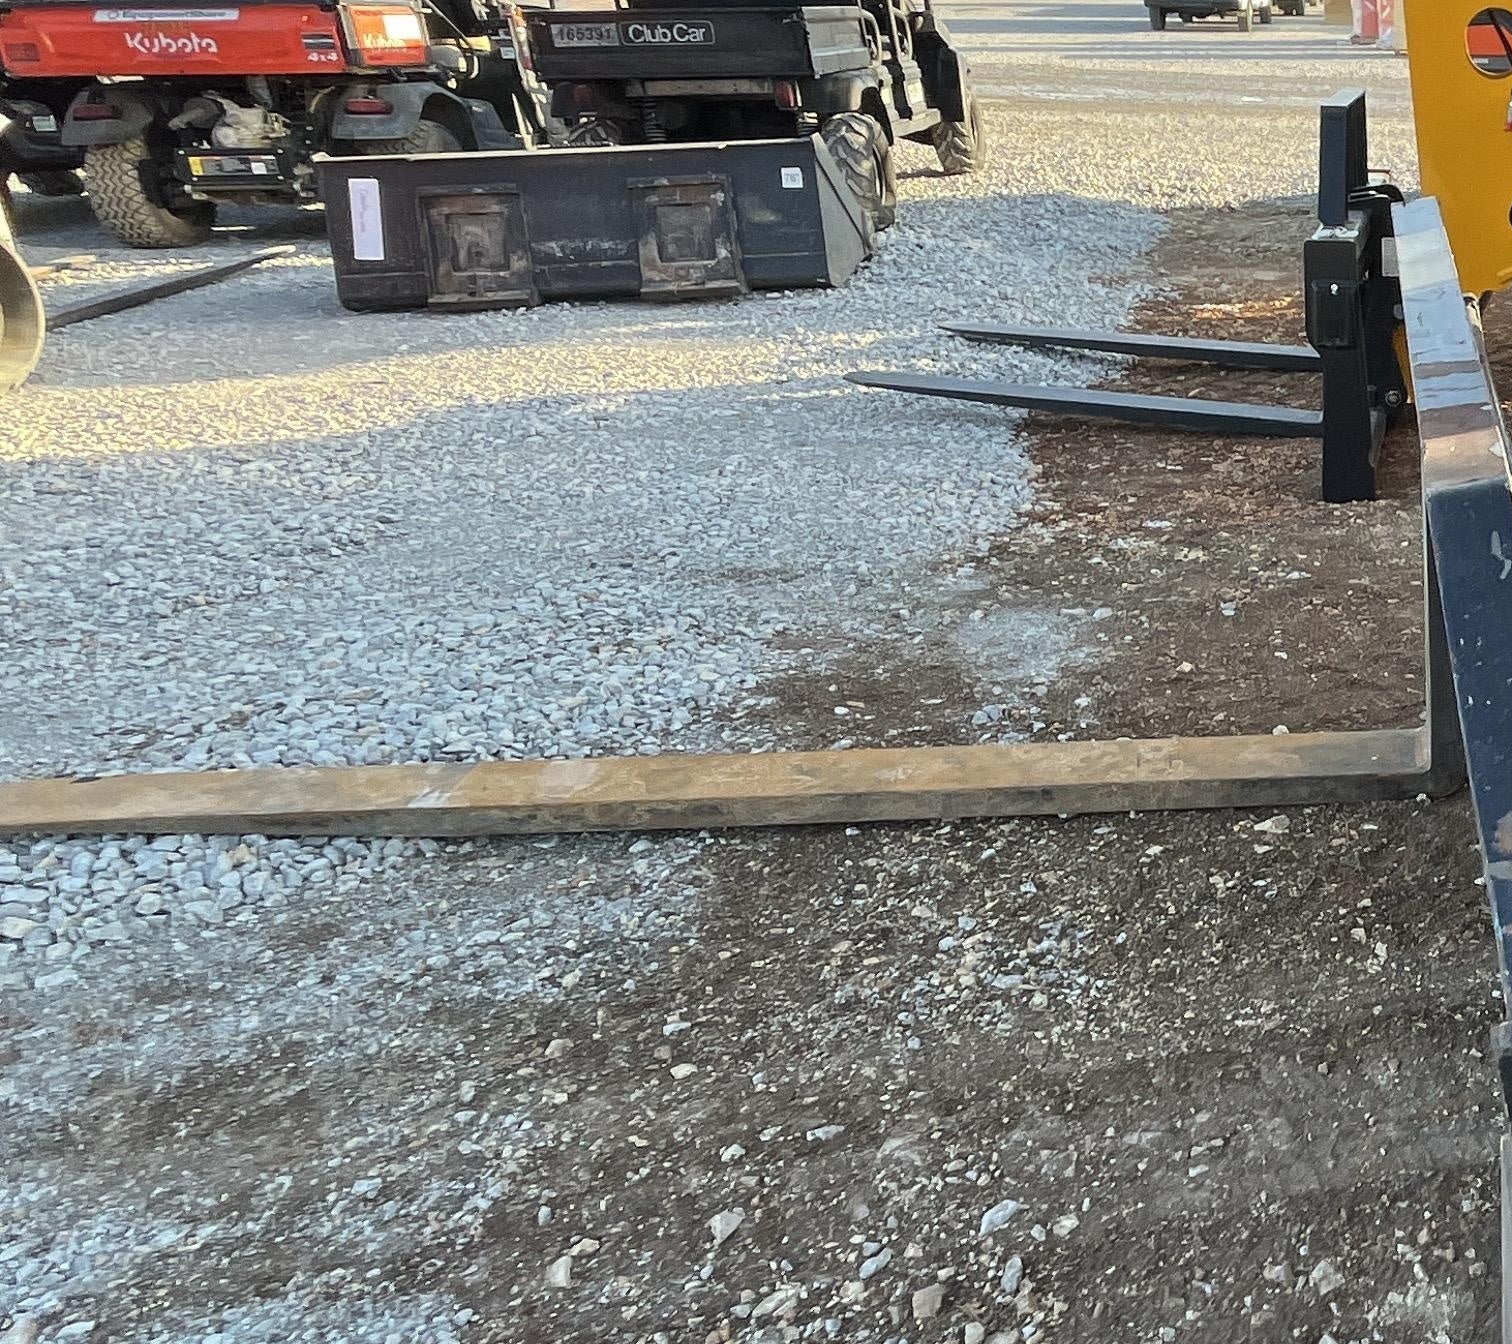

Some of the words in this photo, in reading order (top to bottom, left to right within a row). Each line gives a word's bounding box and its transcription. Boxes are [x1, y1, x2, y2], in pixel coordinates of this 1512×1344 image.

[124, 32, 218, 54] Kubota
[628, 24, 671, 43] Club
[673, 23, 706, 43] Car
